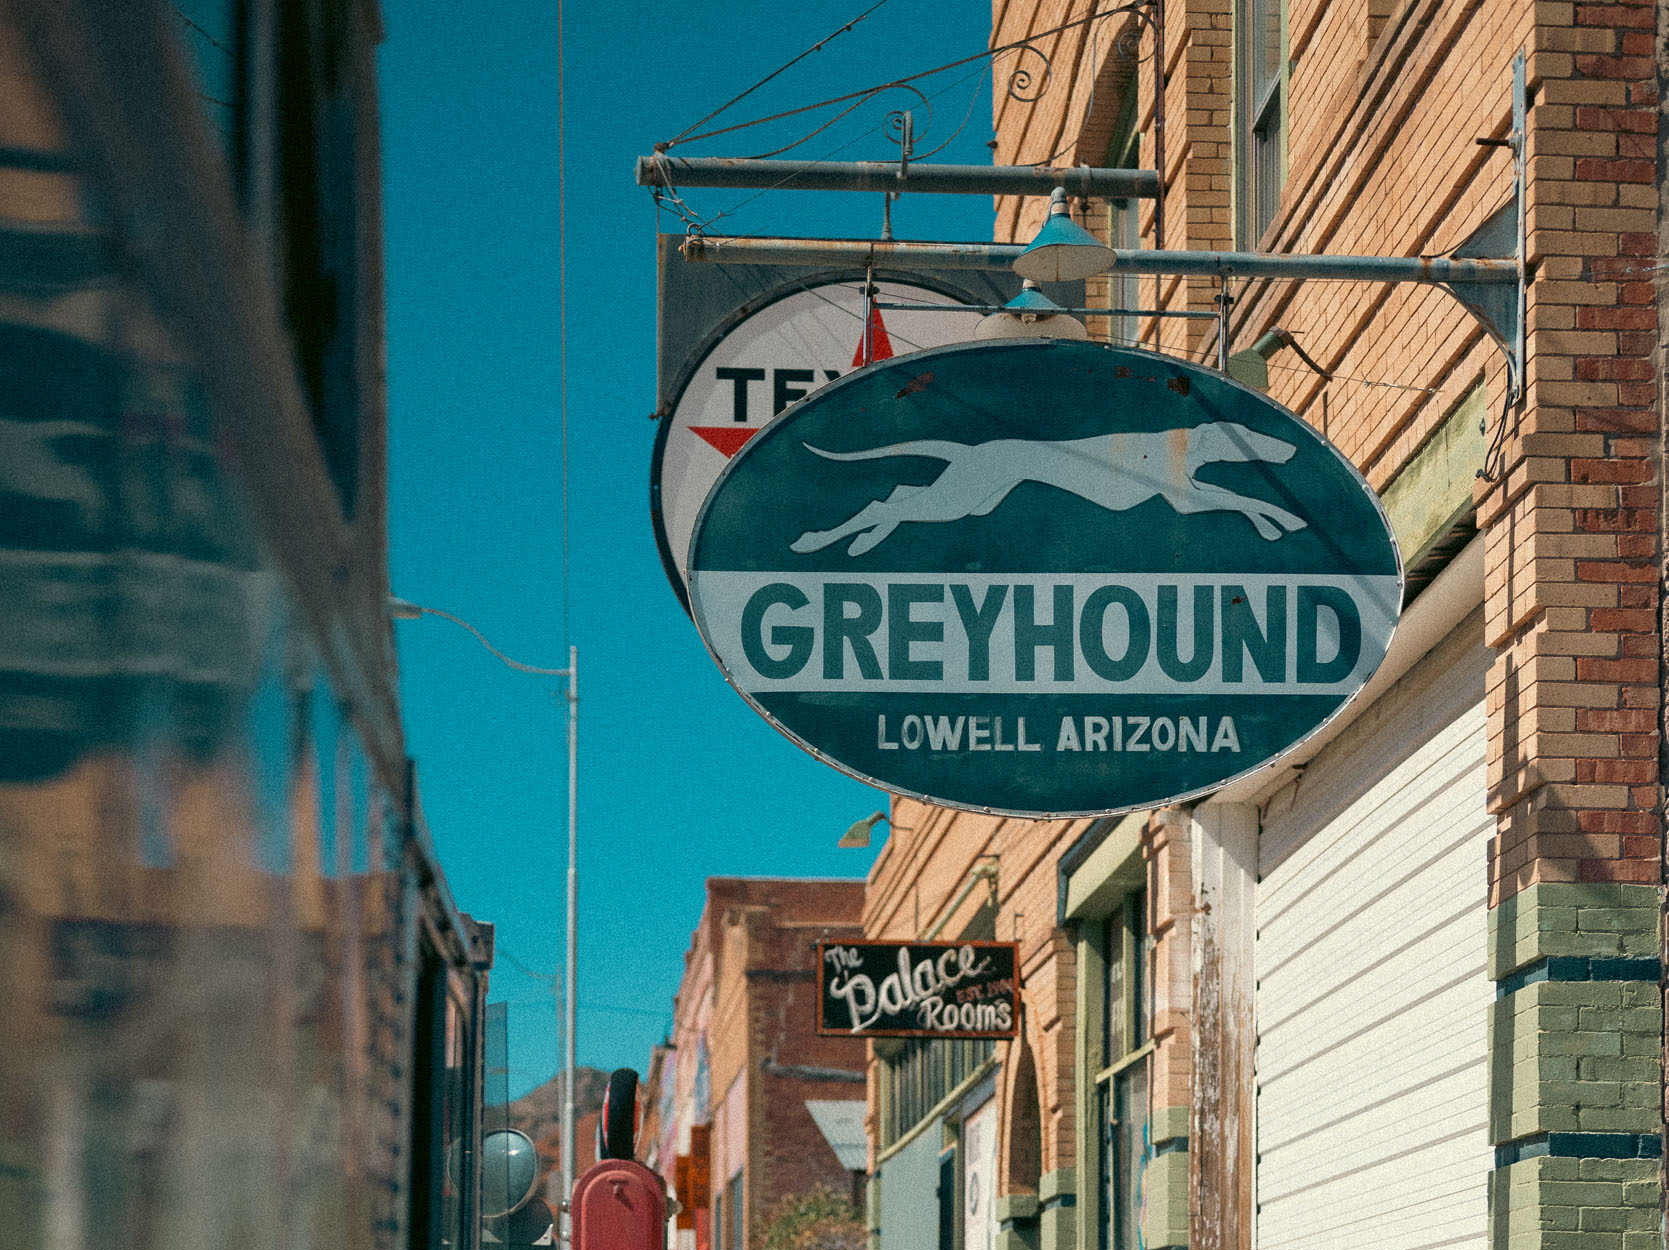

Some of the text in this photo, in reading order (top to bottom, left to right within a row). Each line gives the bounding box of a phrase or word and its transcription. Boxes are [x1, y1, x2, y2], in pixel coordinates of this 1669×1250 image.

[716, 367, 841, 422] TE
[740, 582, 1362, 683] GREYHOUND
[878, 714, 1241, 752] LOWELL ARIZONA
[824, 945, 864, 974] The
[830, 945, 992, 1033] Palace
[918, 996, 1012, 1031] Rooms
